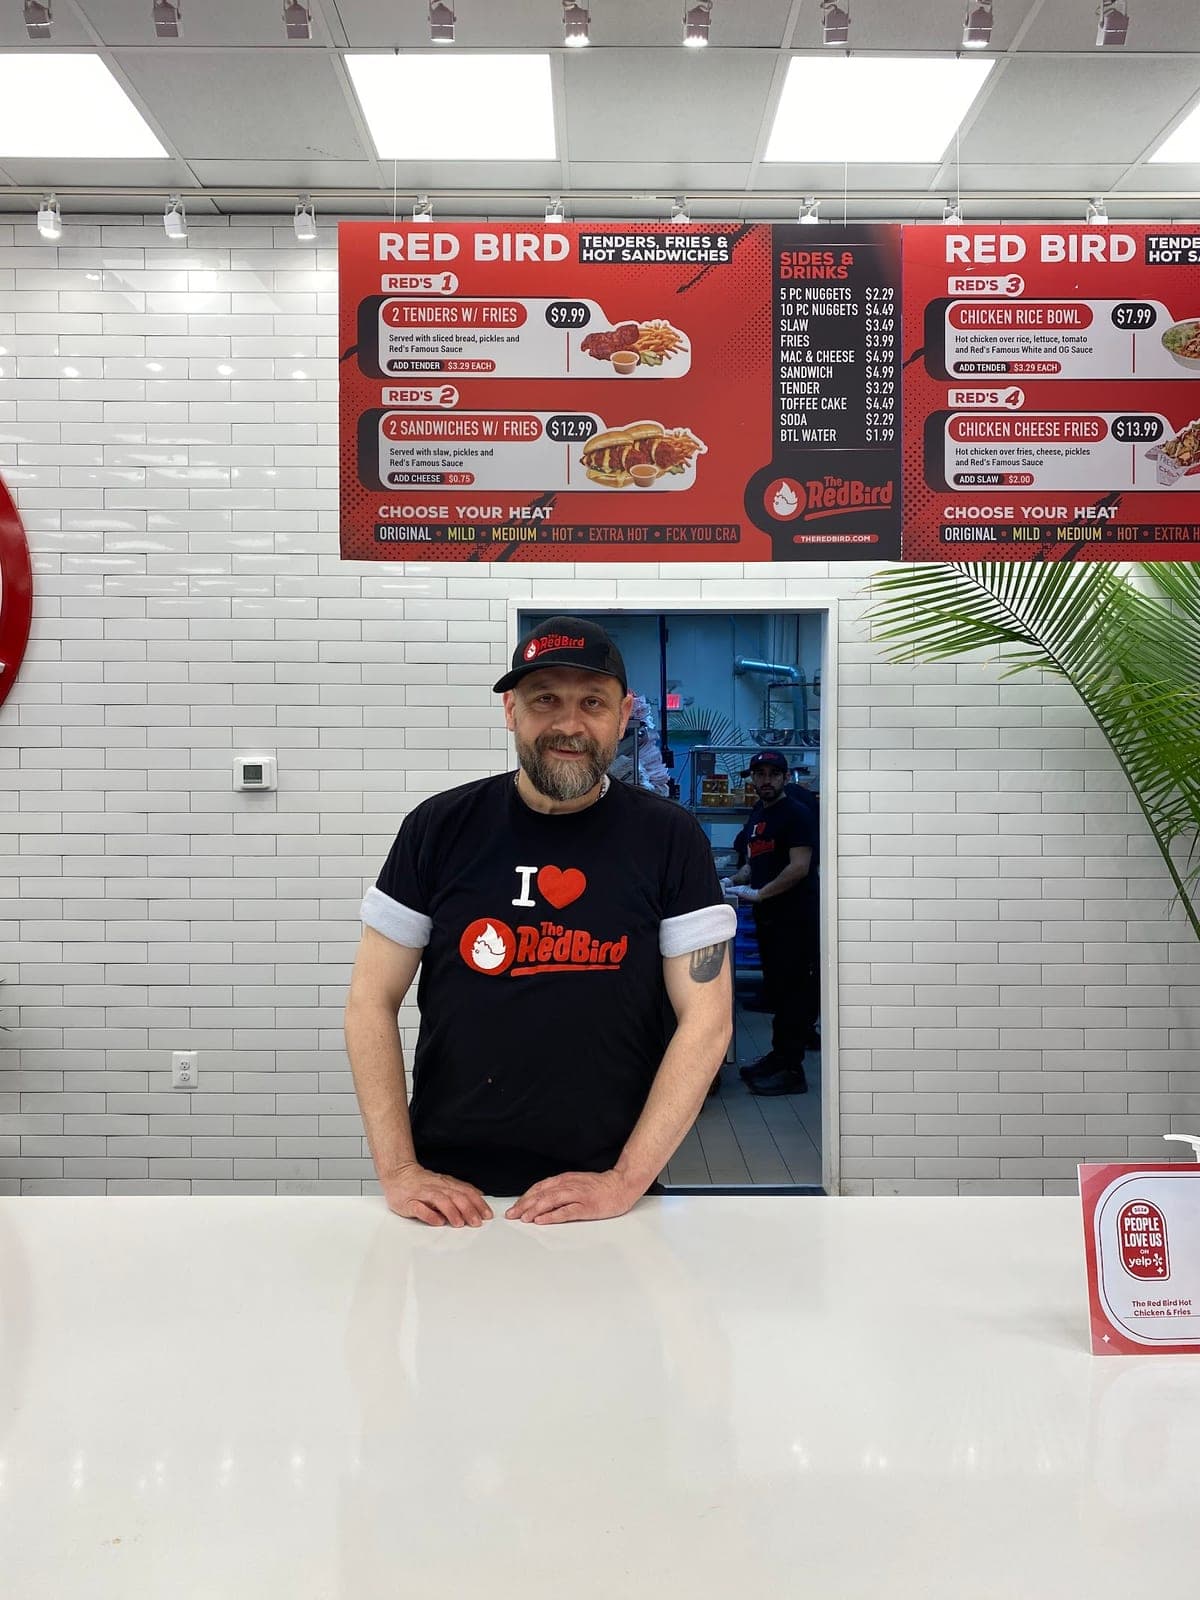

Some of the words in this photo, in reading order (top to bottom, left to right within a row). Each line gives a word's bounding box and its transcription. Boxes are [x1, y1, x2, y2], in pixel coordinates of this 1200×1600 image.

[379, 232, 460, 262] RED
[474, 232, 570, 262] BIRD
[582, 236, 660, 249] TENDERS,
[665, 236, 711, 248] FRIES
[717, 236, 728, 248] &
[945, 234, 1027, 263] RED
[1040, 234, 1137, 263] BIRD
[582, 250, 615, 262] HOT
[622, 250, 729, 262] SANDWICHES
[780, 252, 834, 266] SIDES
[841, 252, 854, 266] &
[1149, 250, 1182, 262] HOT
[780, 266, 849, 280] DRINKS
[388, 277, 433, 289] RED'S
[441, 274, 453, 291] 1
[955, 280, 998, 291] RED'S
[1006, 278, 1021, 294] 3
[780, 287, 786, 300] 5
[790, 287, 802, 300] PC
[805, 287, 852, 300] NUGGETS
[865, 287, 894, 300] $2.29
[392, 307, 400, 322] 2
[403, 307, 458, 322] TENDERS
[462, 307, 479, 324] W/
[482, 307, 517, 322] FRIES
[551, 306, 585, 324] $9.99
[781, 303, 793, 316] 10
[796, 303, 809, 316] PC
[812, 303, 858, 316] NUGGETS
[865, 303, 894, 316] $4.49
[960, 309, 1010, 325] CHICKEN
[1016, 309, 1043, 325] RICE
[1047, 309, 1081, 325] BOWL
[1117, 309, 1151, 325] $7.99
[780, 318, 809, 332] SLAW
[865, 318, 894, 332] $3.49
[389, 334, 414, 342] Served
[415, 334, 430, 342] with
[433, 334, 454, 342] sliced
[455, 334, 478, 344] bread,
[479, 334, 504, 344] pickles
[506, 334, 520, 342] and
[780, 334, 810, 347] FRIES
[865, 334, 894, 347] $3.99
[1016, 335, 1032, 344] rice,
[1033, 335, 1060, 344] lettuce,
[780, 350, 802, 363] MAC
[806, 350, 814, 363] &
[816, 350, 855, 363] CHEESE
[865, 350, 894, 363] $4.99
[955, 346, 968, 354] and
[971, 346, 990, 354] Red's
[992, 346, 1020, 354] Famous
[1021, 346, 1040, 354] White
[1044, 346, 1056, 354] and
[1059, 346, 1069, 354] OG
[1071, 346, 1093, 354] Sauce
[393, 362, 409, 370] ADD
[410, 362, 440, 370] TENDER
[448, 362, 470, 370] $3.29
[472, 362, 492, 370] EACH
[780, 366, 832, 378] SANDWICH
[865, 366, 894, 378] $4.99
[959, 364, 975, 372] ADD
[977, 364, 1006, 372] TENDER
[1014, 364, 1035, 372] $3.29
[1037, 364, 1057, 372] EACH
[780, 382, 820, 394] TENDER
[865, 382, 894, 394] $3.29
[388, 391, 433, 402] RED'S
[440, 388, 455, 404] 2
[955, 392, 998, 403] RED'S
[1004, 390, 1021, 406] 4
[780, 397, 818, 410] TOFFEE
[821, 397, 847, 410] CAKE
[865, 397, 894, 410] $4.49
[780, 413, 807, 426] SODA
[865, 413, 894, 426] $2.29
[390, 421, 397, 436] 2
[400, 421, 479, 436] SANDWICHES
[482, 421, 499, 437] W/
[503, 421, 538, 436] FRIES
[551, 421, 593, 437] $12.99
[780, 429, 799, 442] BTL
[802, 429, 837, 442] WATER
[865, 429, 894, 442] $1.99
[958, 422, 1010, 437] CHICKEN
[1014, 422, 1060, 437] CHEESE
[1064, 422, 1099, 437] FRIES
[1117, 422, 1158, 437] $13.99
[390, 448, 414, 456] Served
[416, 448, 432, 456] with
[433, 448, 452, 457] slaw,
[453, 448, 478, 458] pickles
[480, 448, 494, 456] and
[955, 448, 968, 456] Hot
[970, 448, 997, 456] chicken
[1016, 448, 1034, 457] fries,
[1036, 448, 1063, 457] cheese,
[1065, 448, 1090, 458] pickles
[393, 474, 409, 483] ADD
[411, 474, 440, 483] CHEESE
[449, 474, 470, 483] $0.75
[824, 476, 842, 487] The
[959, 475, 975, 484] ADD
[977, 475, 999, 484] SLAW
[1008, 475, 1030, 484] $2.00
[806, 480, 893, 508] RedBird
[378, 506, 449, 519] CHOOSE
[456, 506, 503, 519] YOUR
[509, 506, 553, 519] HEAT
[943, 507, 1014, 519] CHOOSE
[1021, 507, 1068, 519] YOUR
[1074, 507, 1118, 519] HEAT
[380, 526, 432, 541] ORIGINAL
[448, 526, 475, 541] MILD
[492, 526, 537, 541] MEDIUM
[552, 526, 574, 541] HOT
[589, 526, 624, 541] EXTRA
[628, 526, 648, 541] HOT
[666, 526, 687, 541] FCK
[690, 526, 712, 541] YOU
[715, 526, 737, 541] CRA
[944, 527, 996, 541] ORIGINAL
[1013, 527, 1040, 541] MILD
[1057, 527, 1102, 541] MEDIUM
[1117, 527, 1139, 541] HOT
[1154, 527, 1190, 541] EXTRA
[540, 636, 585, 650] RedBird
[512, 866, 538, 907] I
[540, 922, 563, 936] The
[517, 926, 628, 963] RedBird
[1124, 1217, 1160, 1231] PEOPLE
[1124, 1233, 1148, 1247] LOVE
[1149, 1233, 1162, 1247] US
[1128, 1256, 1152, 1268] yelp
